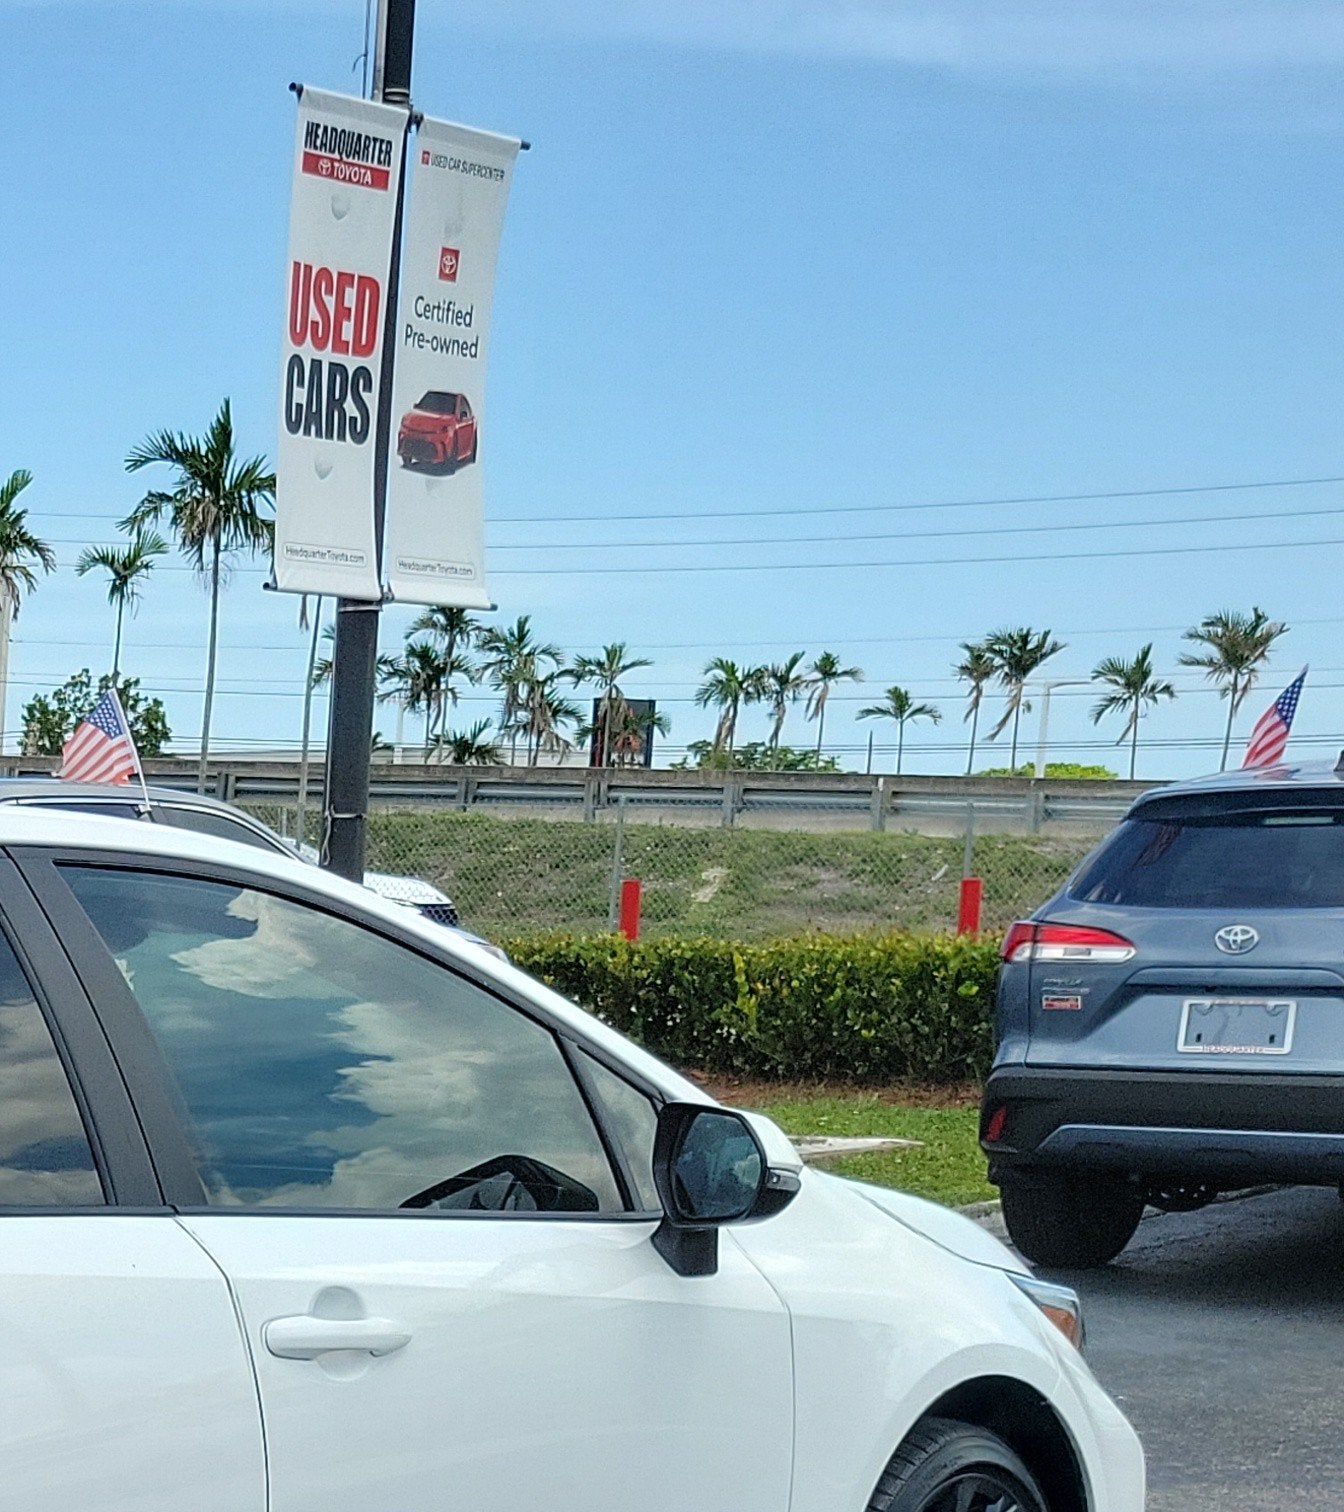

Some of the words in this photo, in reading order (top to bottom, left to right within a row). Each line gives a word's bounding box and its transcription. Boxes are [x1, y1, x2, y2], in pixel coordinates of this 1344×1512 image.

[304, 120, 393, 168] HEADQUARTER
[333, 161, 372, 185] TOYOTA
[431, 154, 448, 169] USED
[448, 157, 461, 171] CAR
[461, 160, 505, 181] SUPERCENTER
[289, 260, 380, 358] USED
[414, 295, 474, 328] Certified
[404, 323, 479, 358] Pre-owned
[285, 353, 373, 445] CARS
